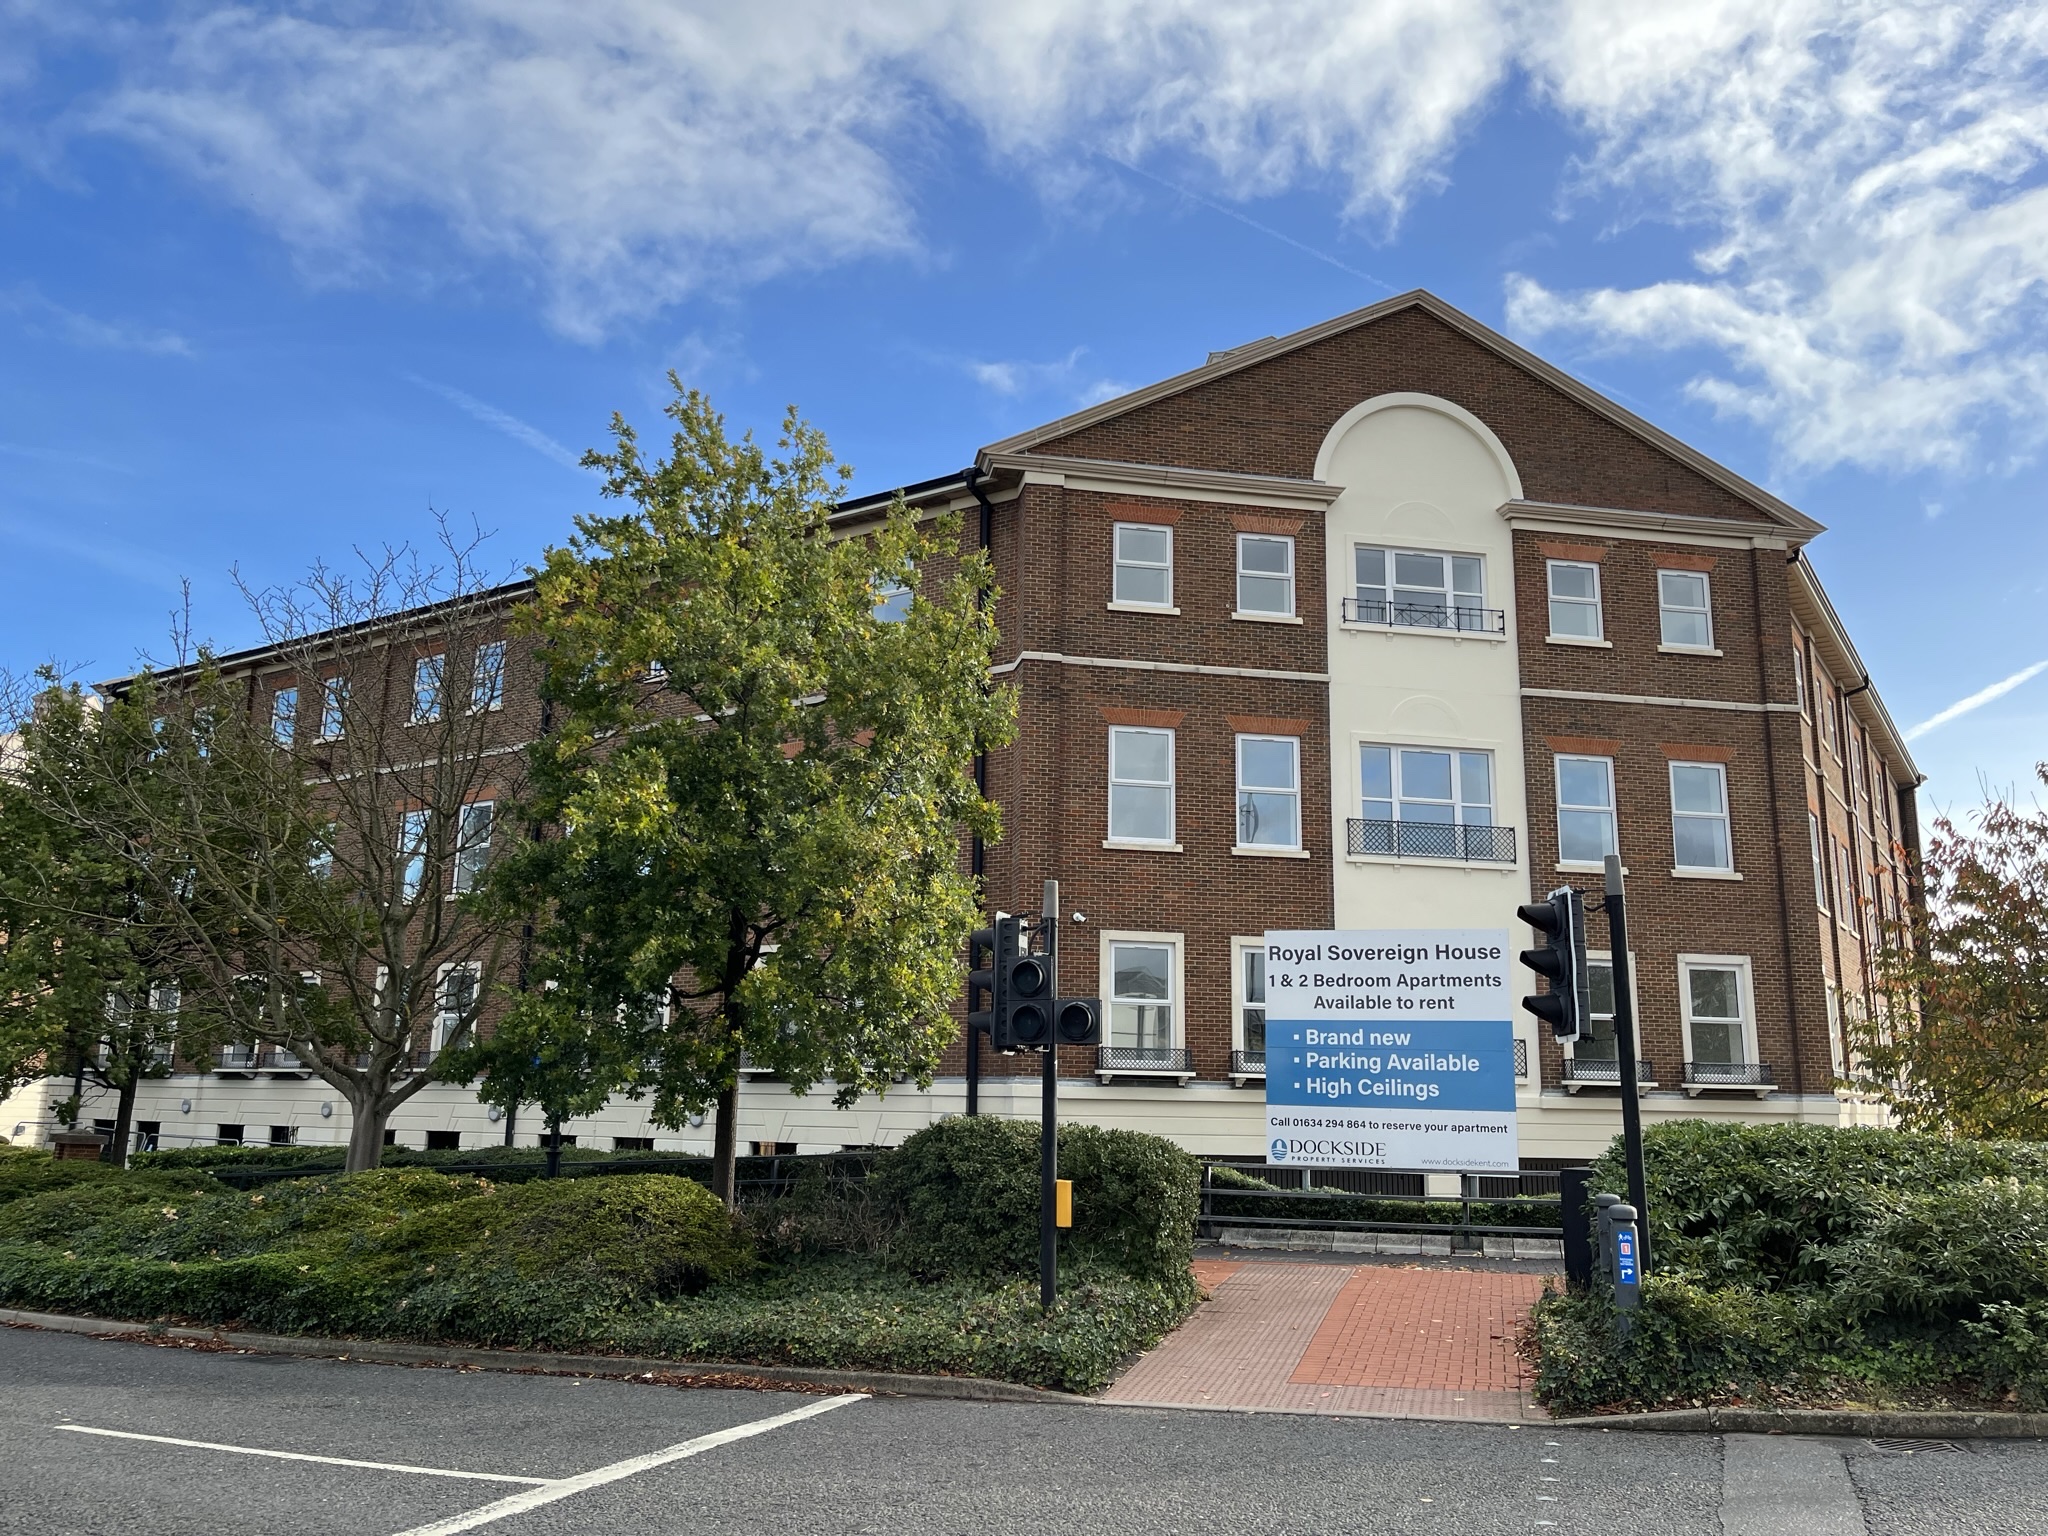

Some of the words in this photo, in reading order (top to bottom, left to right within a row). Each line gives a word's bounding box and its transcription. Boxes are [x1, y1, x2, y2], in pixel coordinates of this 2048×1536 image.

[1269, 945, 1321, 964] Royal
[1328, 945, 1428, 964] Sovereign
[1436, 944, 1501, 960] House
[1269, 975, 1274, 987] 1
[1281, 975, 1293, 987] &
[1299, 975, 1308, 987] 2
[1314, 974, 1391, 988] Bedroom
[1396, 974, 1502, 990] Apartments
[1314, 996, 1392, 1009] Available
[1397, 997, 1414, 1009] to
[1419, 996, 1455, 1009] rent
[1306, 1029, 1363, 1046] Brand
[1370, 1033, 1411, 1046] new
[1306, 1053, 1381, 1073] Parking
[1387, 1054, 1480, 1072] Available
[1306, 1078, 1351, 1099] High
[1358, 1079, 1439, 1100] Ceilings
[1271, 1117, 1290, 1127] Call
[1293, 1118, 1322, 1128] 01634
[1325, 1120, 1344, 1128] 294
[1347, 1120, 1366, 1129] 864
[1369, 1121, 1379, 1129] to
[1382, 1122, 1421, 1131] reserve
[1424, 1124, 1448, 1134] your
[1451, 1124, 1508, 1134] apartment
[1290, 1140, 1386, 1157] DOCKSIDE
[1421, 1157, 1509, 1167] www.docksidekent.com
